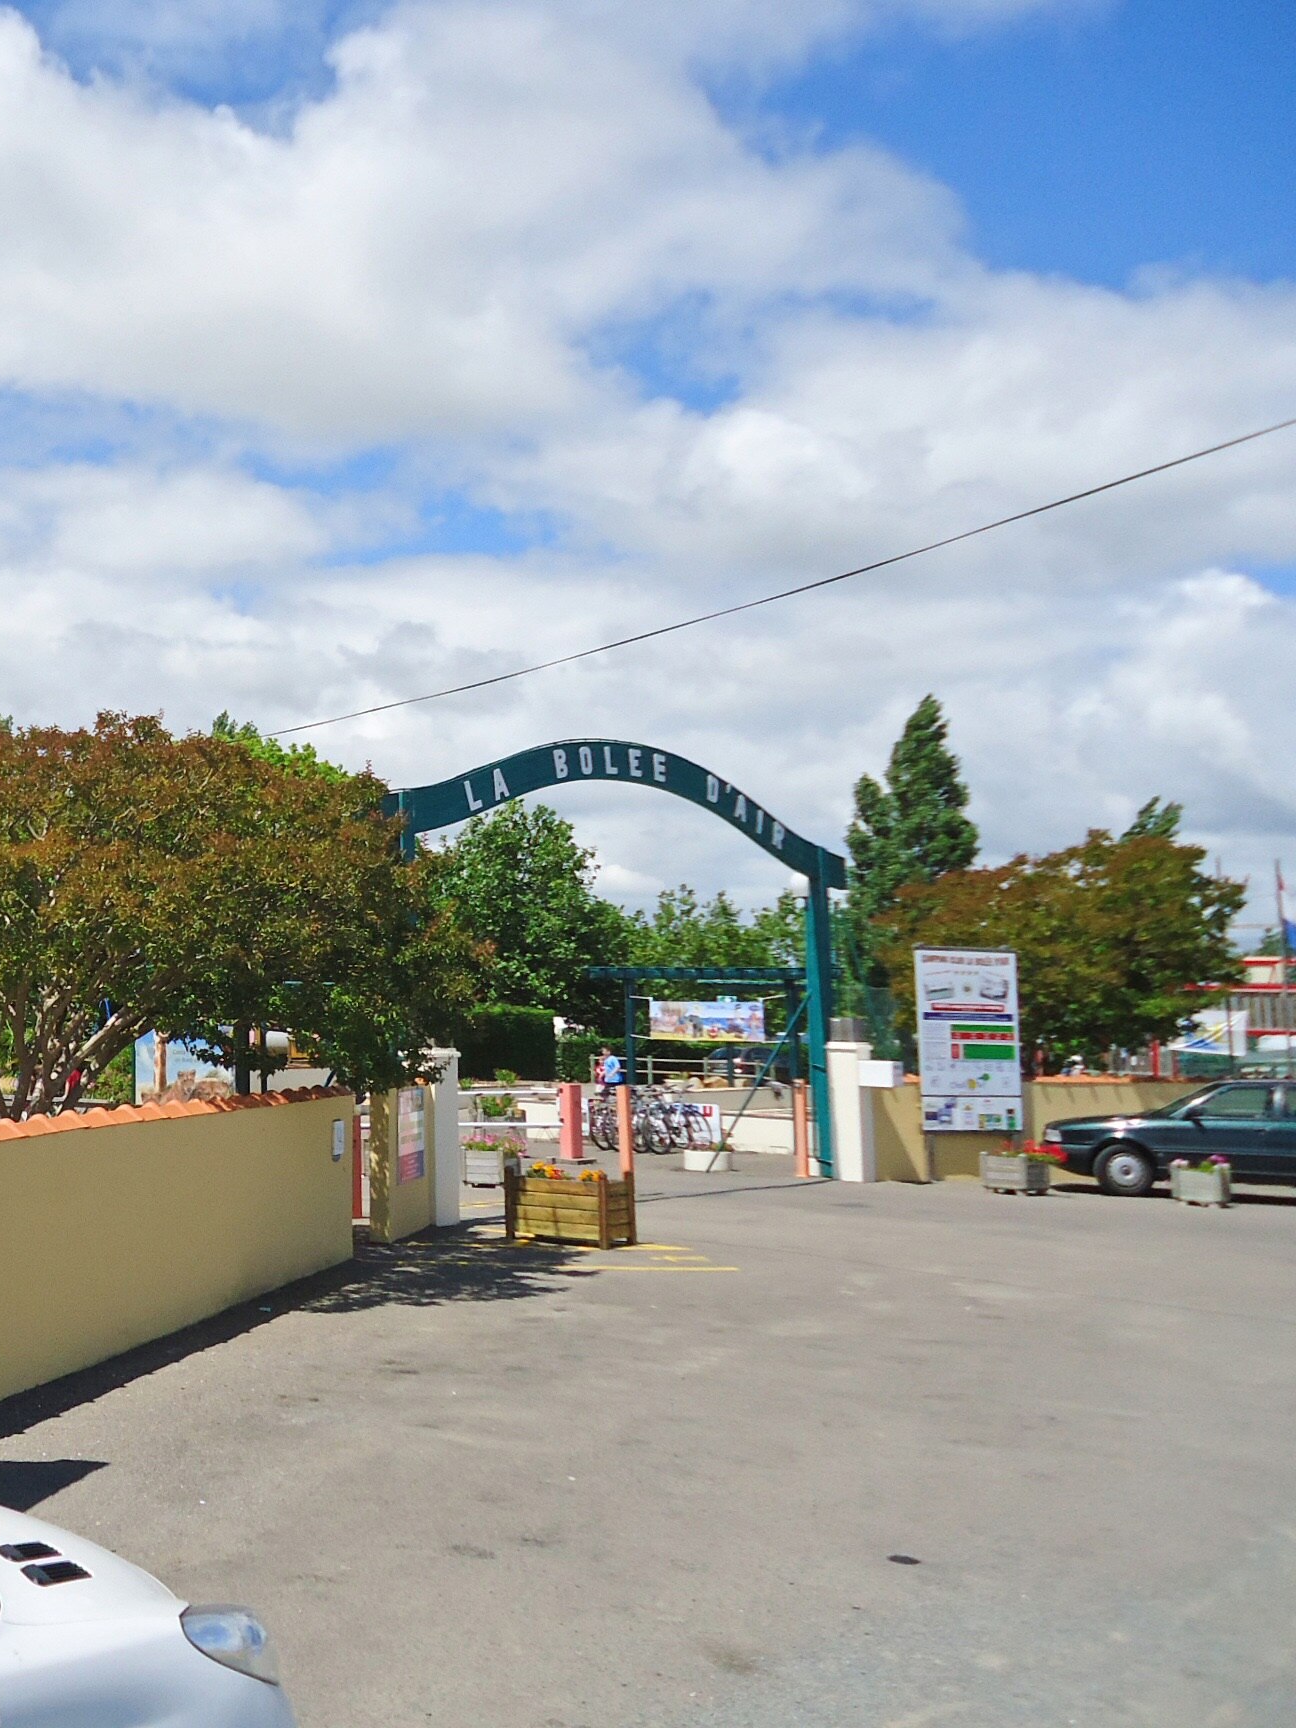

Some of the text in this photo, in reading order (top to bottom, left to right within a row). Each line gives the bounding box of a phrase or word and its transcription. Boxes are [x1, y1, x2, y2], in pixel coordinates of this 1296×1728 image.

[463, 746, 785, 849] LA BOLEE D'AIR
